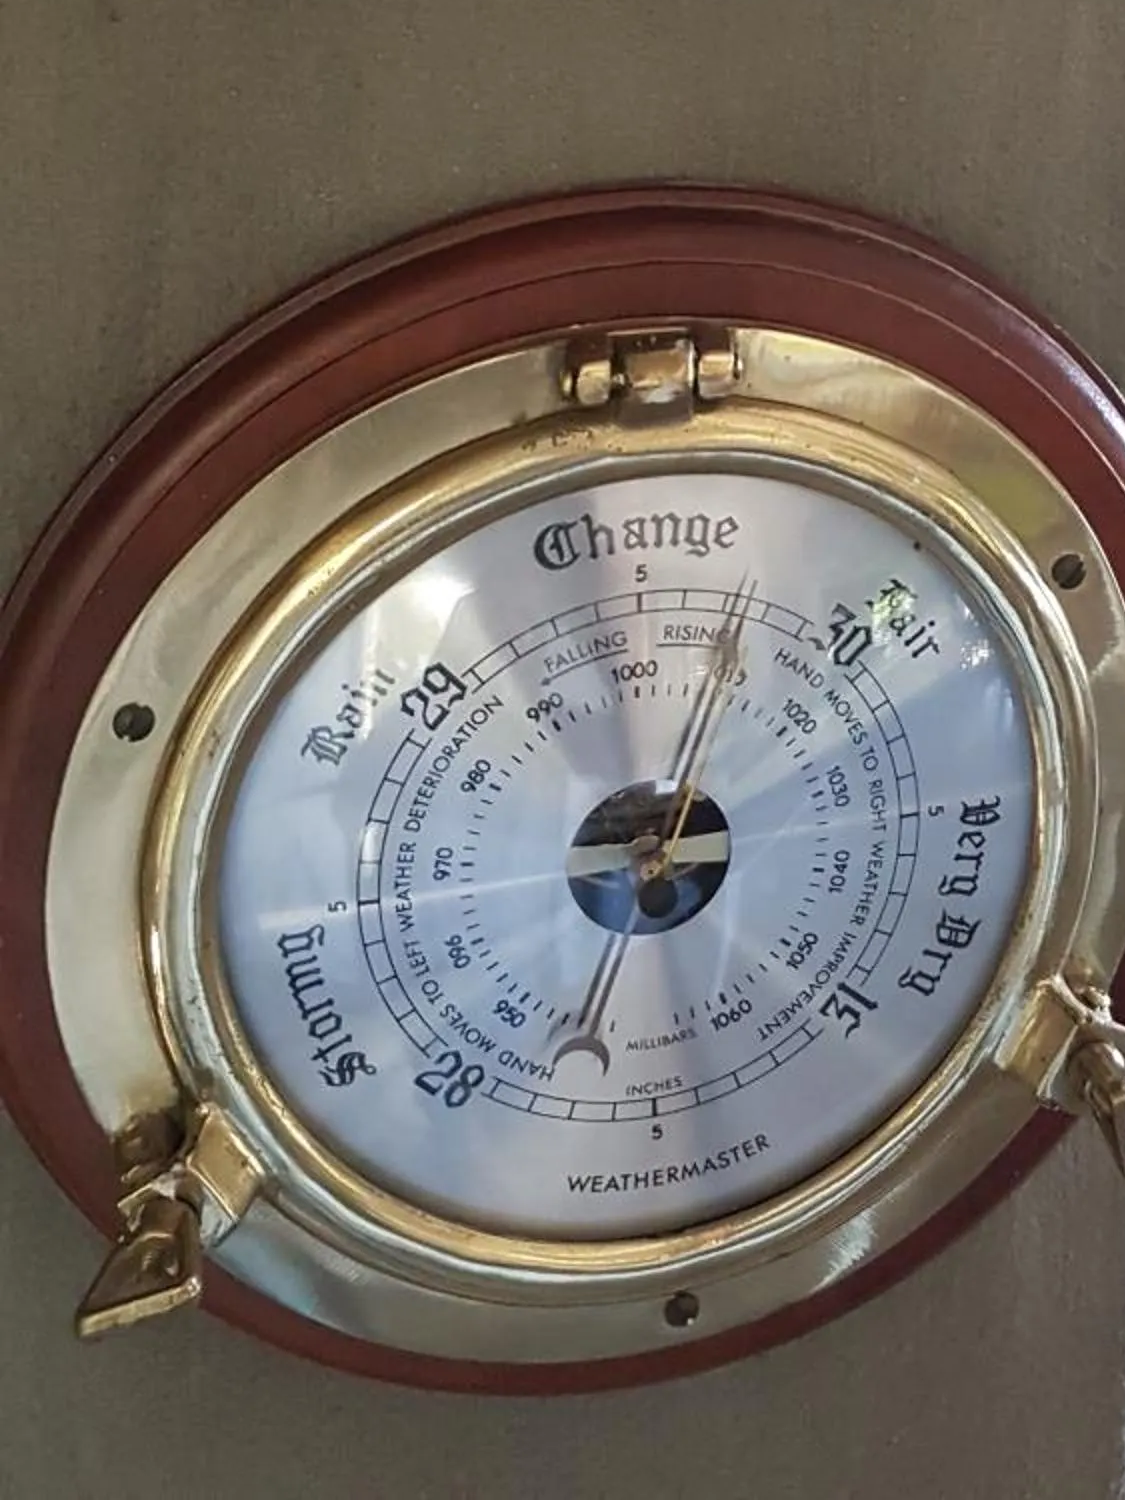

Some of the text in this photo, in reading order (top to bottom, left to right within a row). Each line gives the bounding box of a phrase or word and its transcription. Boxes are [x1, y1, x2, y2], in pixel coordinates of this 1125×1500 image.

[533, 510, 740, 573] Change
[634, 564, 649, 583] 5
[544, 631, 628, 672] FALLING
[829, 603, 873, 667] 30
[610, 659, 658, 682] 1000
[400, 662, 467, 731] 29
[525, 692, 564, 723] 990
[300, 668, 396, 767] Rain
[782, 698, 818, 736] 1020
[459, 758, 492, 794] 980
[827, 764, 850, 808] 1030
[928, 804, 945, 818] 5
[432, 846, 454, 882] 970
[757, 647, 888, 1042] HAND MOVES TO RIGHT WEATHER IMPROVEMENT
[395, 695, 556, 1082] HAND MOVES TO LEFT WEATHER DETERIORATION
[828, 848, 851, 894] 1040
[328, 900, 347, 914] 5
[898, 795, 1001, 998] Very Dry
[443, 934, 471, 969] 960
[785, 932, 819, 971] 1050
[277, 923, 377, 1088] Stormy
[492, 999, 527, 1029] 950
[709, 1000, 754, 1033] 1060
[819, 981, 879, 1039] 31
[625, 1028, 698, 1053] MILLIBARS
[414, 1049, 485, 1109] 28
[625, 1075, 684, 1097] INCHES
[651, 1123, 664, 1140] 5
[568, 1133, 771, 1194] WEATHERMASTER
